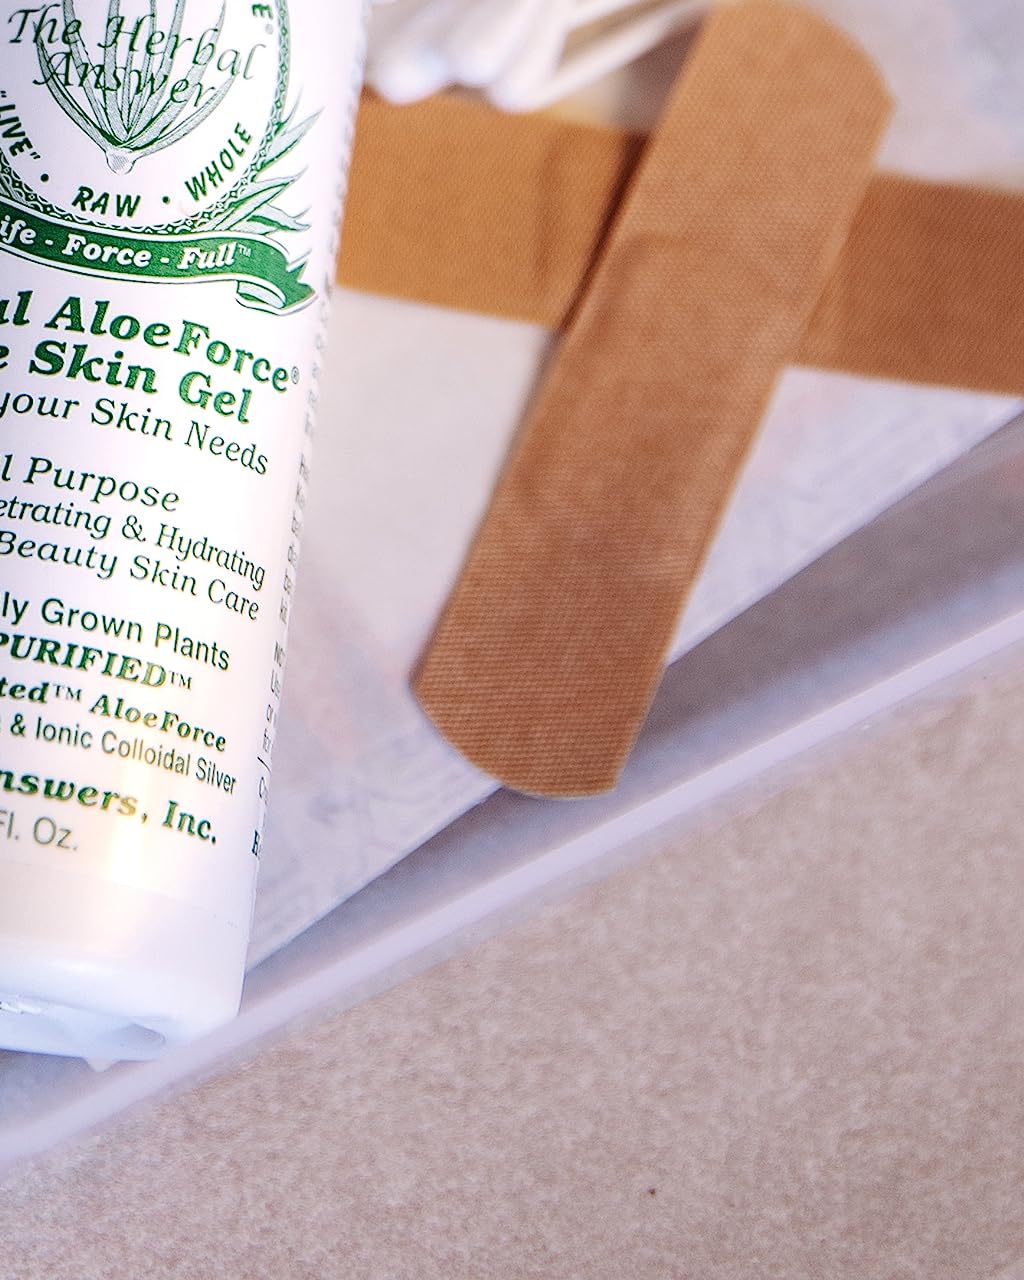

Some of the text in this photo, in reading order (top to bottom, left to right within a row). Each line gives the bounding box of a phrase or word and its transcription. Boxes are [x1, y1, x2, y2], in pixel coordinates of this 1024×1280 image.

[8, 8, 266, 81] The Herbal
[33, 51, 218, 108] Answer
[71, 185, 141, 218] RAW
[184, 122, 252, 202] WHOLE
[63, 236, 149, 267] Force
[28, 339, 158, 394] Skin
[178, 371, 252, 424] Gel
[91, 398, 172, 441] Skin
[184, 420, 268, 475] Needs
[22, 456, 179, 512] Purpose
[121, 515, 146, 542] &
[155, 523, 265, 596] Hydrating
[130, 555, 196, 596] Skin
[208, 579, 259, 620] Care
[41, 597, 142, 643] Grown
[155, 622, 229, 671] Plants
[10, 712, 26, 737] &
[36, 716, 93, 749] Ionic
[102, 730, 190, 776] Colloidal
[196, 757, 236, 795] Silver
[88, 694, 226, 757] AloeForce
[33, 817, 78, 851] Oz.
[162, 800, 216, 845] Inc.
